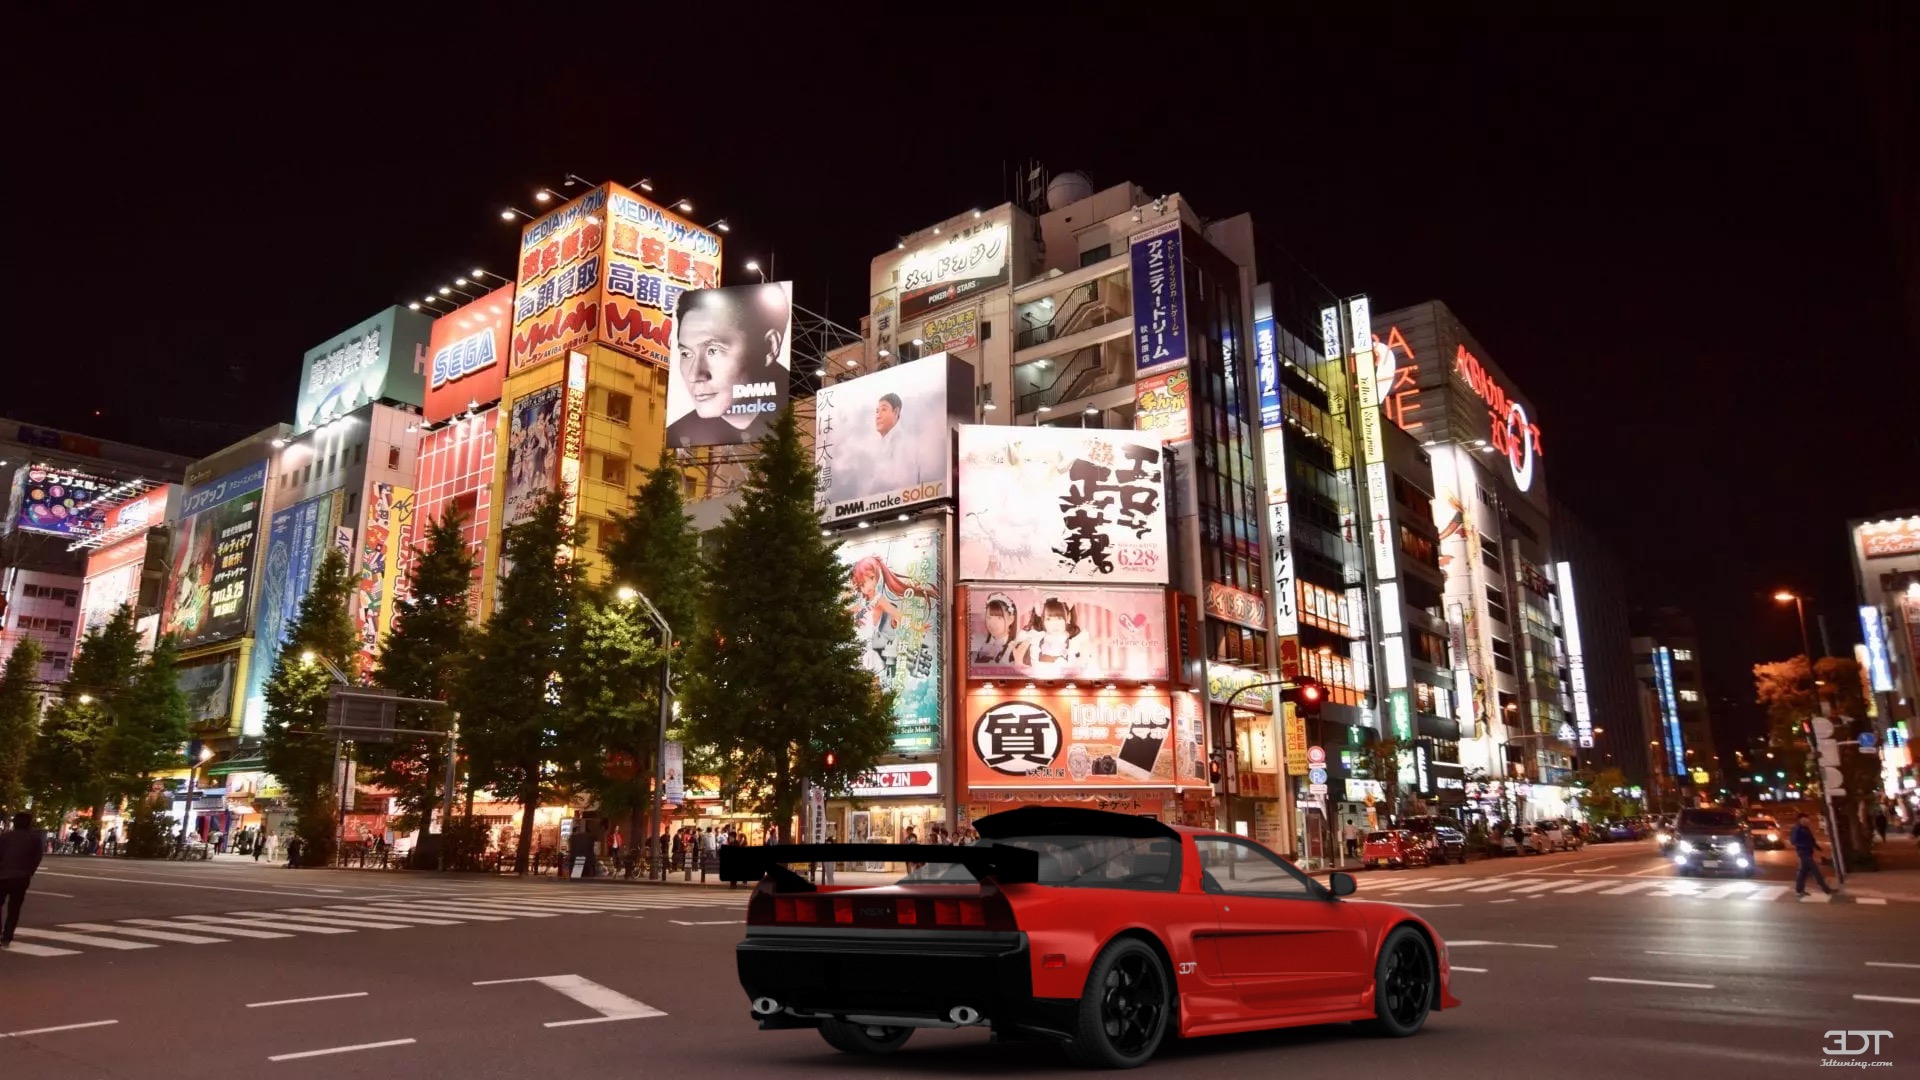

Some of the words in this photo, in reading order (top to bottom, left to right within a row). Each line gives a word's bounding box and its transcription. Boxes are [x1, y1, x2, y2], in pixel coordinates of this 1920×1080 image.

[613, 194, 719, 256] MEDIAリサイクル
[517, 257, 599, 326] 高額買取
[608, 262, 684, 312] 高額買
[928, 292, 947, 304] POKER
[956, 281, 977, 294] STARS
[514, 301, 597, 367] Mulan
[605, 302, 672, 349] Mul
[432, 328, 497, 387] SEGA
[614, 337, 649, 355] ムーラン
[650, 350, 670, 363] AKIB
[732, 381, 777, 398] DMM
[1361, 376, 1370, 404] Yellow
[726, 400, 777, 414] .make
[184, 481, 227, 512] ソフマップ
[835, 494, 900, 518] DMM.make
[902, 482, 944, 504] solar
[901, 726, 914, 735] Scale
[915, 725, 931, 734] Model
[985, 712, 1053, 767] 質
[850, 773, 890, 788] OIC
[892, 772, 911, 787] ZIN
[1098, 799, 1141, 810] チケット
[1179, 962, 1197, 975] 3DT
